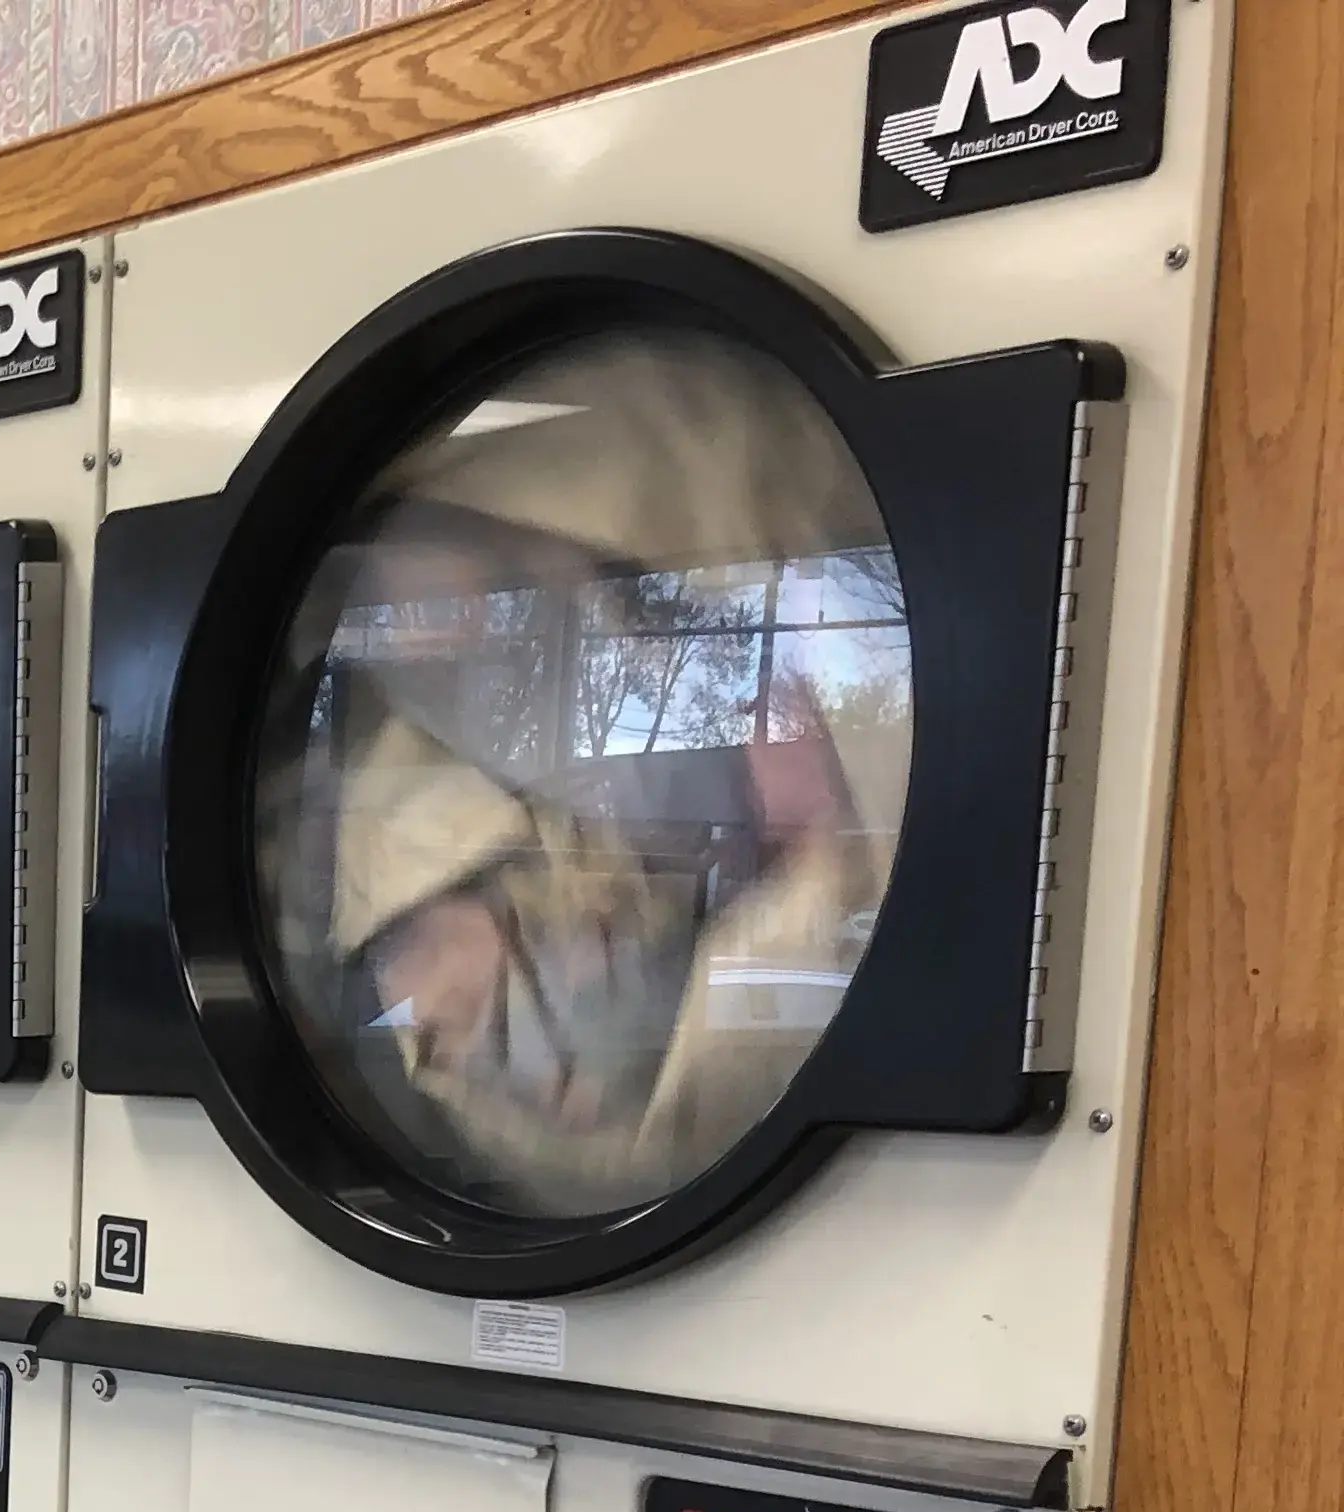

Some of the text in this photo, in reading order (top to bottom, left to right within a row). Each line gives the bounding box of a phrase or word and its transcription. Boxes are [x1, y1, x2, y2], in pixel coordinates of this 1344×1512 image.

[929, 0, 1127, 136] ADC
[948, 108, 1120, 160] American Dryer Corp.
[113, 1238, 128, 1267] 2
